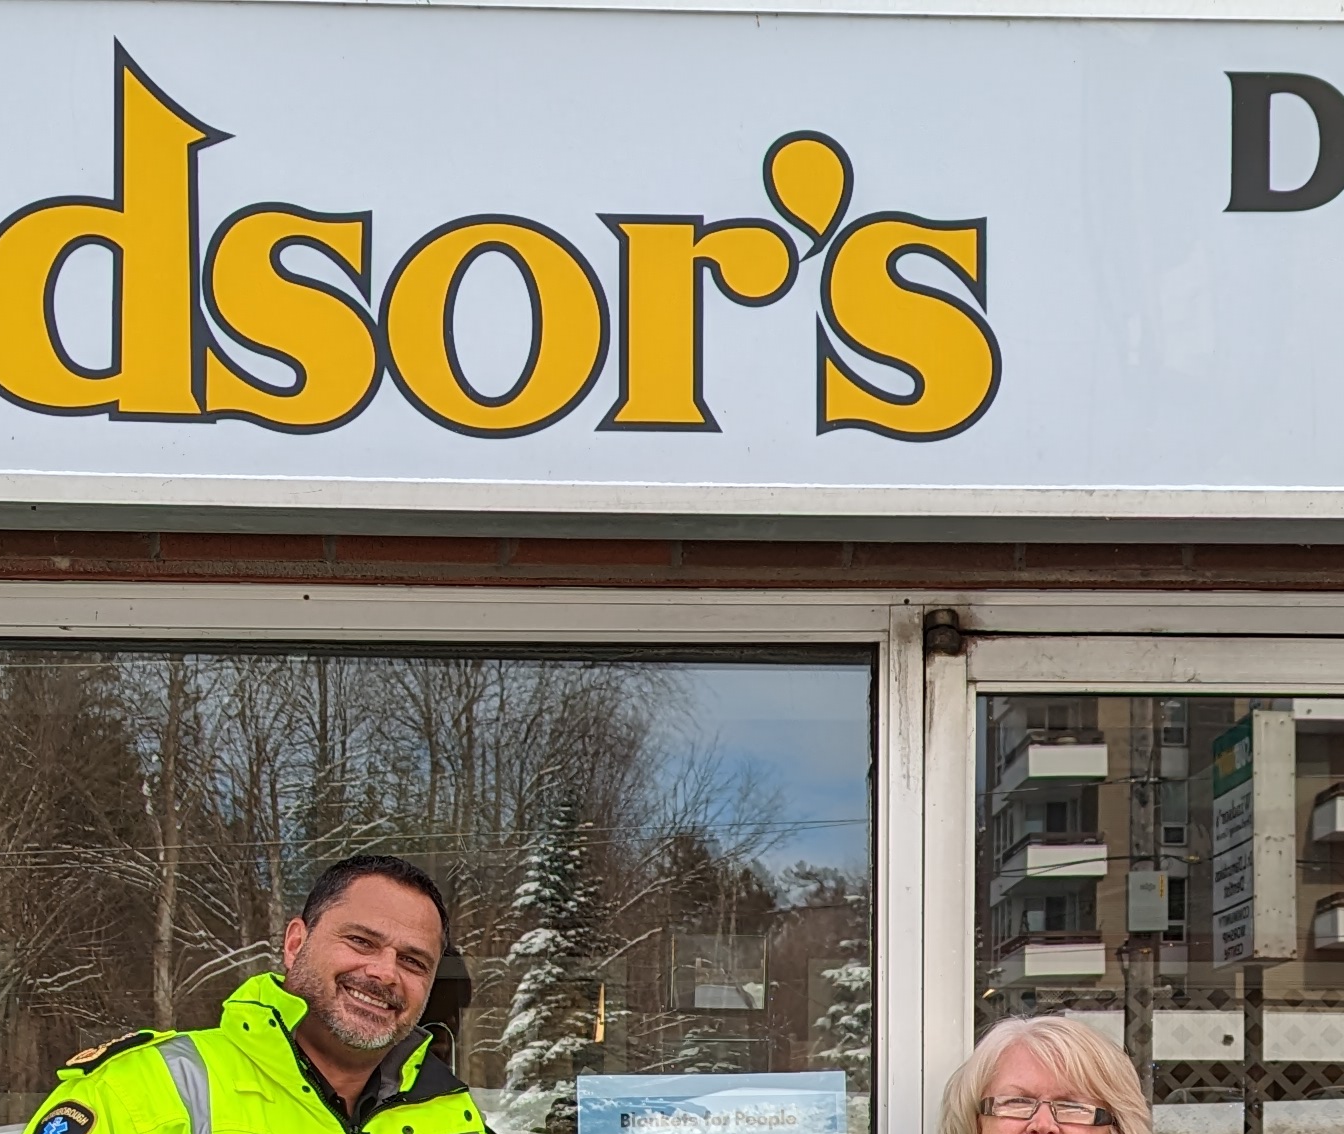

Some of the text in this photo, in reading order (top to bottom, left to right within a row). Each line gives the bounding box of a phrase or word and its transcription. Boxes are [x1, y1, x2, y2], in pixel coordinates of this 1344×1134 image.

[621, 1110, 797, 1129] Blankets for People
